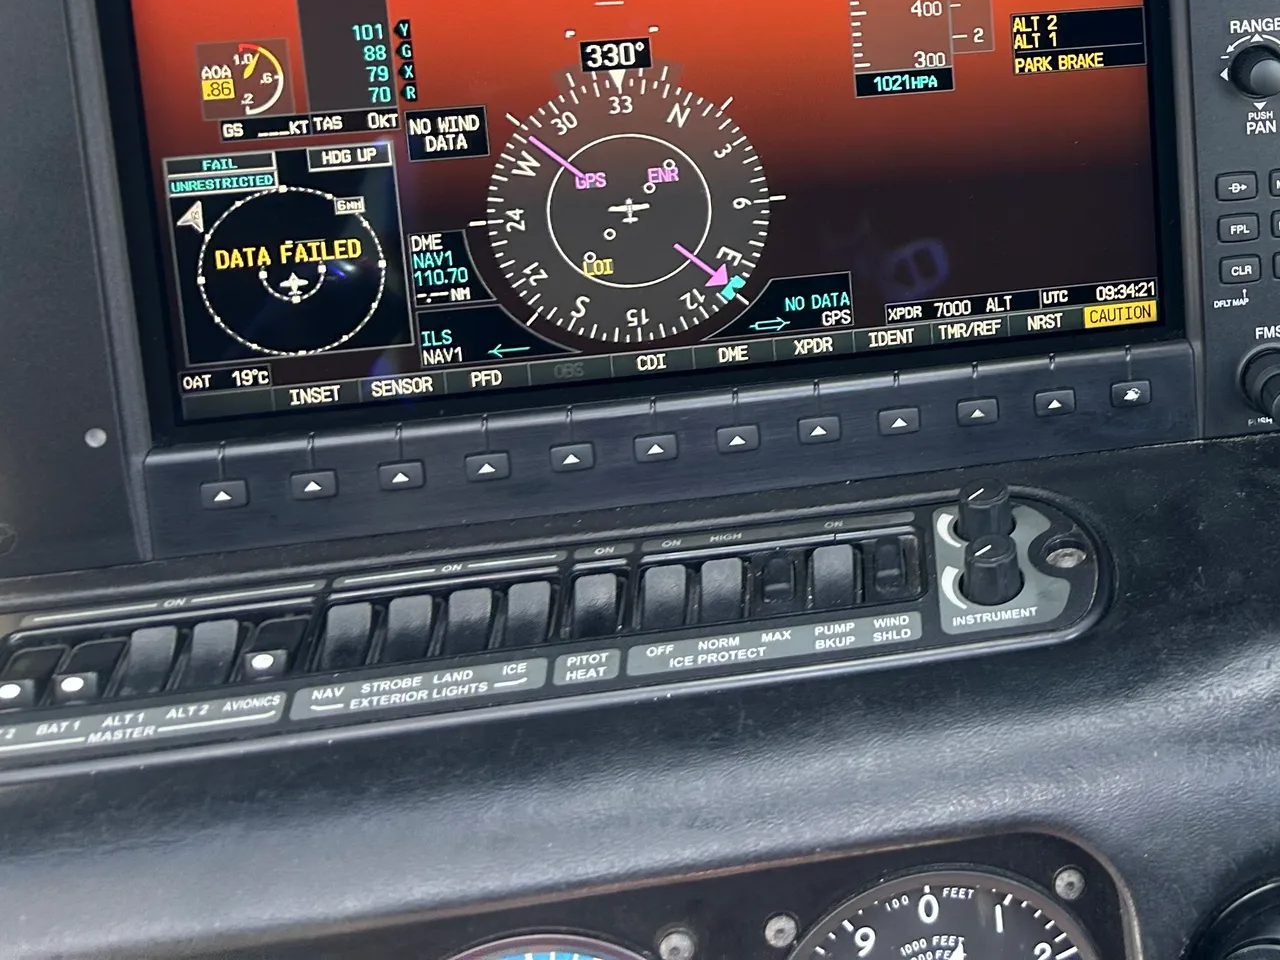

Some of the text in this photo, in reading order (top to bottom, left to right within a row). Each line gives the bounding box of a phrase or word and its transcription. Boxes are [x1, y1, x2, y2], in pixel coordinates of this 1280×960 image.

[911, 0, 942, 17] 400
[352, 24, 384, 41] 101
[1013, 16, 1039, 32] ALT
[1014, 33, 1040, 49] ALT
[363, 44, 386, 61] 88
[914, 51, 946, 68] 300
[1015, 52, 1104, 73] PARK BRAKE
[201, 65, 232, 80] AOA
[366, 65, 389, 82] 79
[368, 86, 391, 103] 70
[608, 96, 633, 115] 33
[409, 115, 479, 135] NO WIND
[1246, 120, 1276, 135] PAN
[425, 135, 468, 152] DATA
[322, 148, 376, 164] HDG UP
[202, 159, 238, 171] FAIL
[170, 174, 274, 193] UNRESTRICTED
[1230, 224, 1250, 235] FPL
[411, 235, 442, 250] DME
[214, 239, 361, 270] DATA FAILED
[413, 251, 453, 269] NAV1
[414, 267, 468, 286] 110.70
[1231, 265, 1252, 276] CLR
[785, 292, 850, 312] NO DATA
[887, 282, 1155, 321] XPDR 7000 ALT UTC 09:34:21
[822, 310, 851, 326] GPS
[422, 330, 452, 346] ILS
[290, 305, 1151, 404] INSET SENSOR PFD CDI DME XPDR IDENT TMR/REF NRST CAUTION
[423, 347, 463, 365] NAV1
[183, 374, 212, 389] OAT
[952, 607, 1038, 626] INSTRUMENT
[646, 615, 909, 658] OFF NORM MAX PUMP WIND
[814, 628, 911, 650] BKUP SHLD
[566, 652, 609, 666] PITOT
[669, 647, 767, 668] ICE PROTECT
[312, 663, 527, 701] NAV STROBE LAND ICE
[566, 667, 606, 681] HEAT
[349, 682, 488, 710] EXTERIOR LIGHTS
[36, 695, 281, 735] BAT ALT ALT AVIONICS
[87, 726, 156, 744] MASTER
[943, 887, 974, 900] FEET
[918, 894, 939, 924] 0
